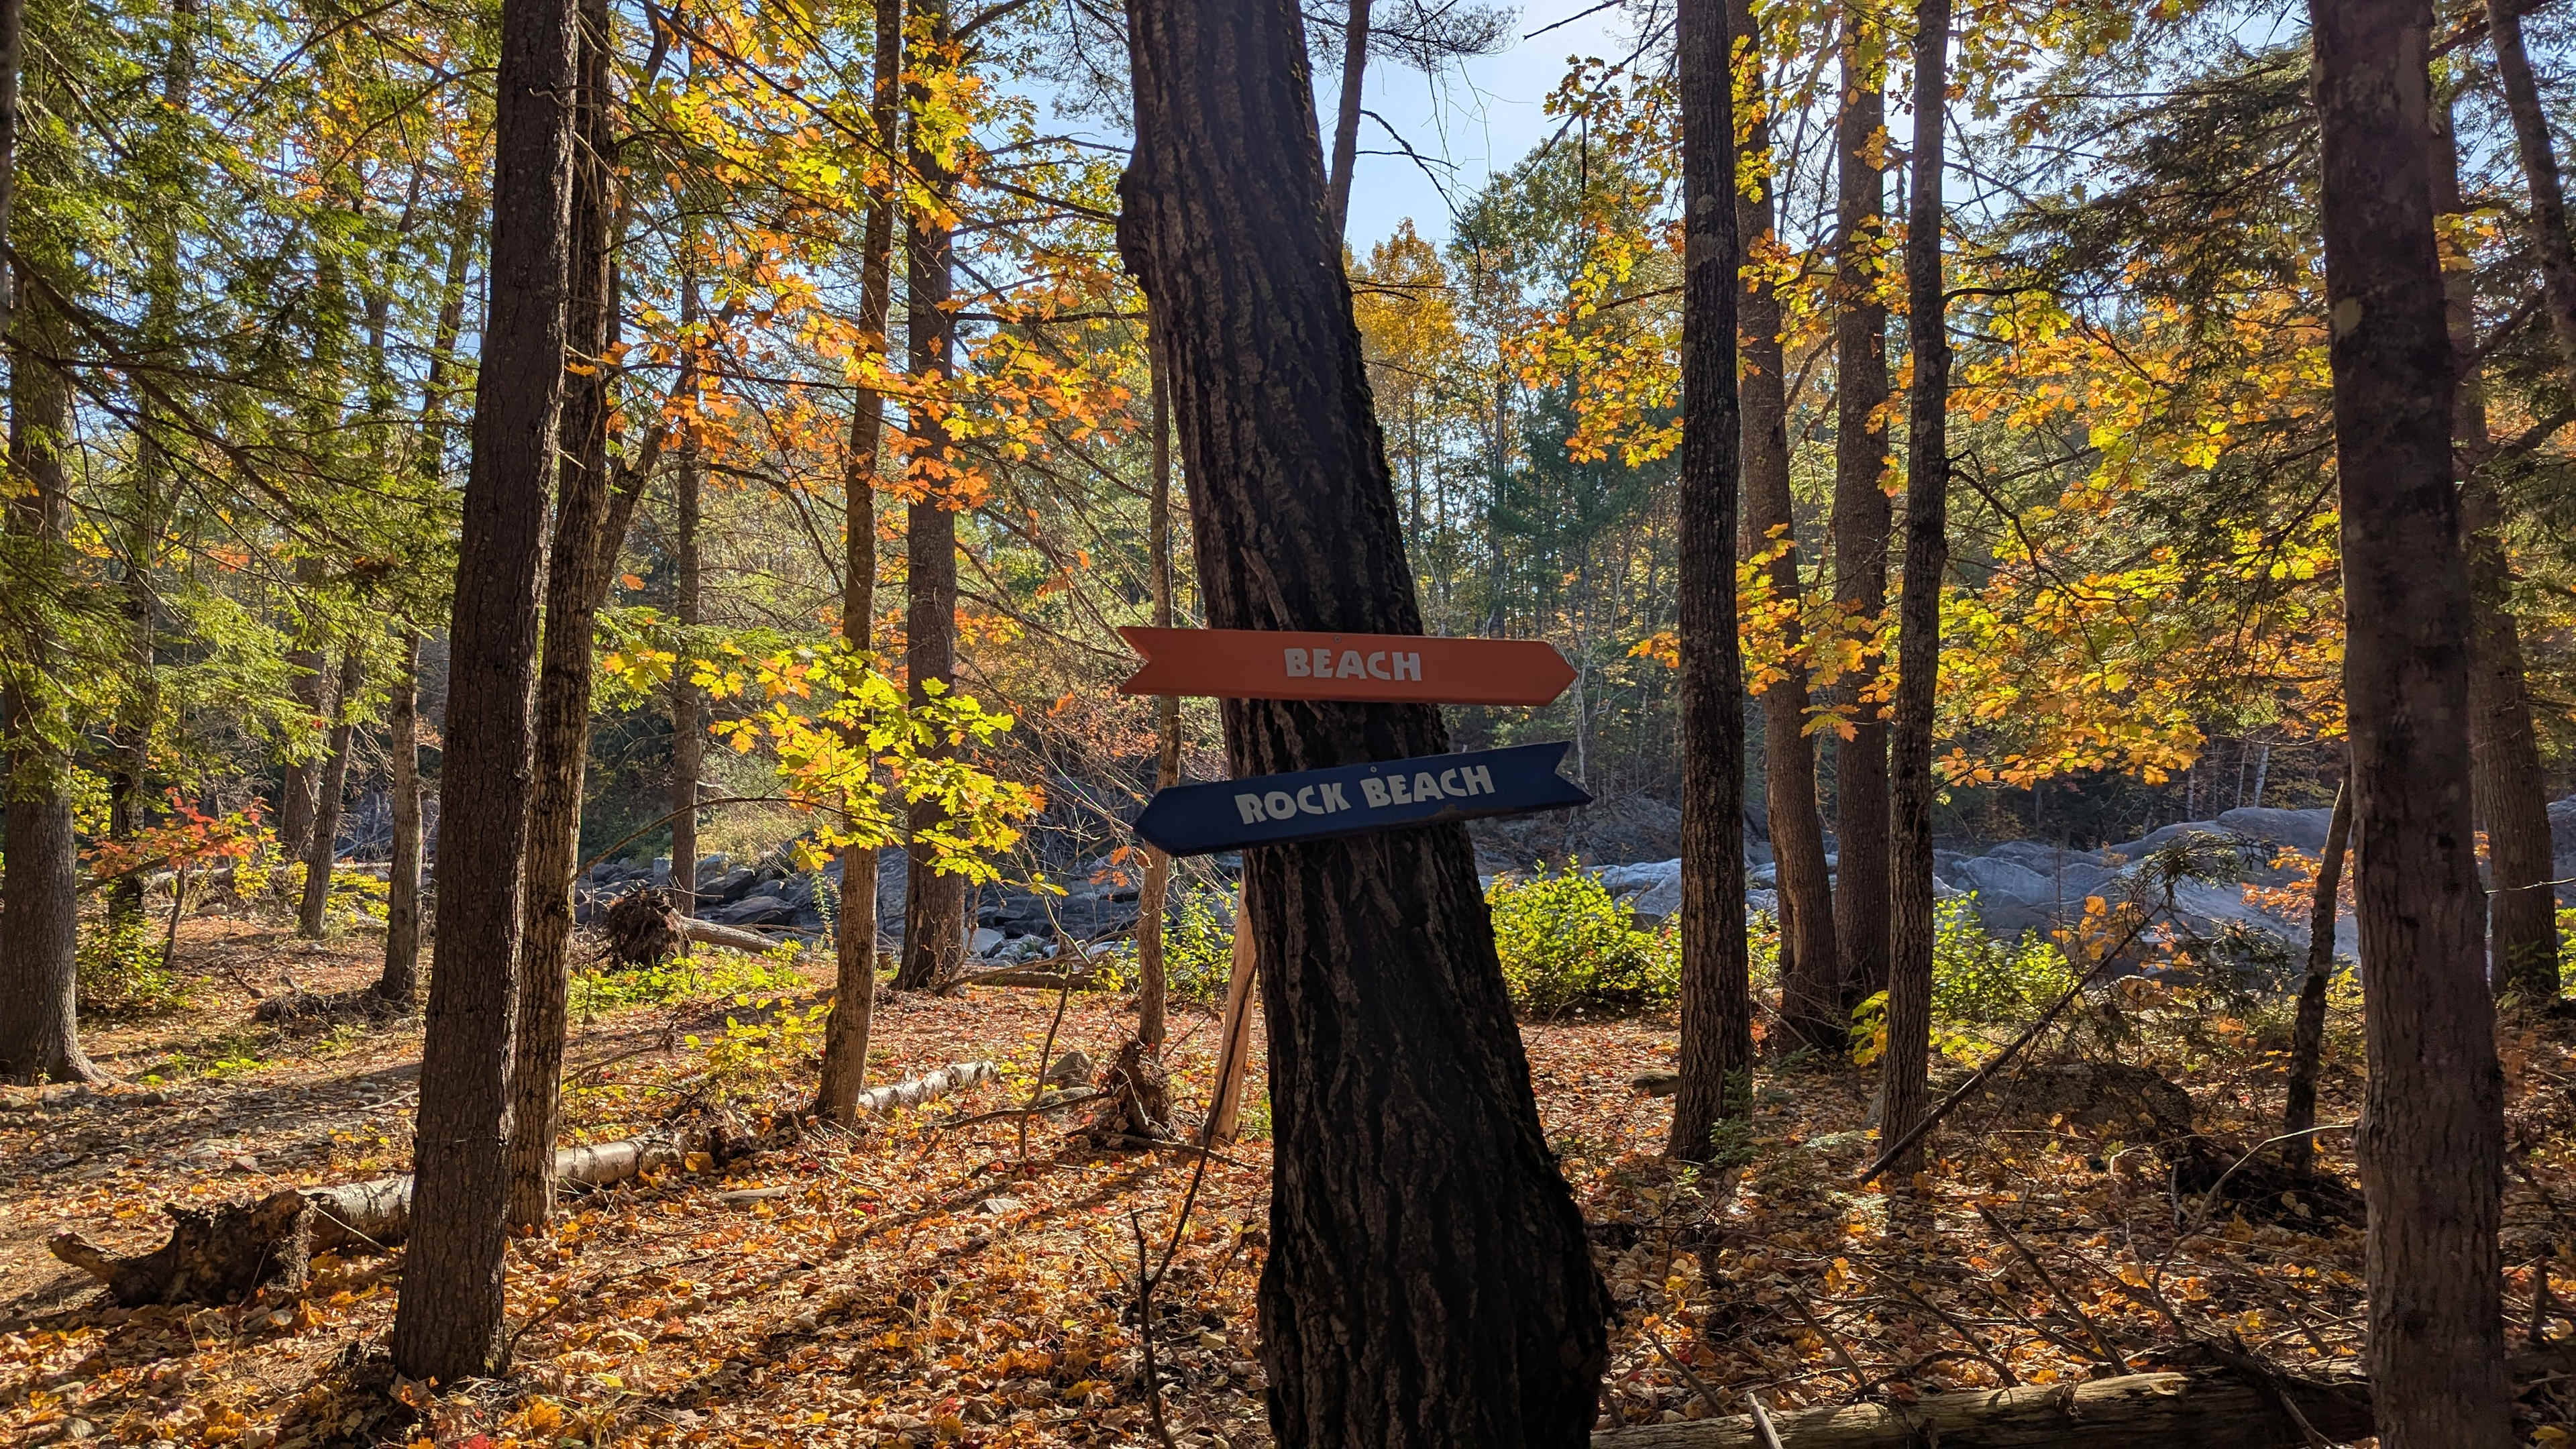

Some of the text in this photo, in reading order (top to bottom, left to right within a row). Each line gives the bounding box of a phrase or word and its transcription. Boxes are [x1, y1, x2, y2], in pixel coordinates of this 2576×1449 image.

[1284, 648, 1421, 682] BEACH
[1234, 765, 1495, 824] ROCK BEACH
